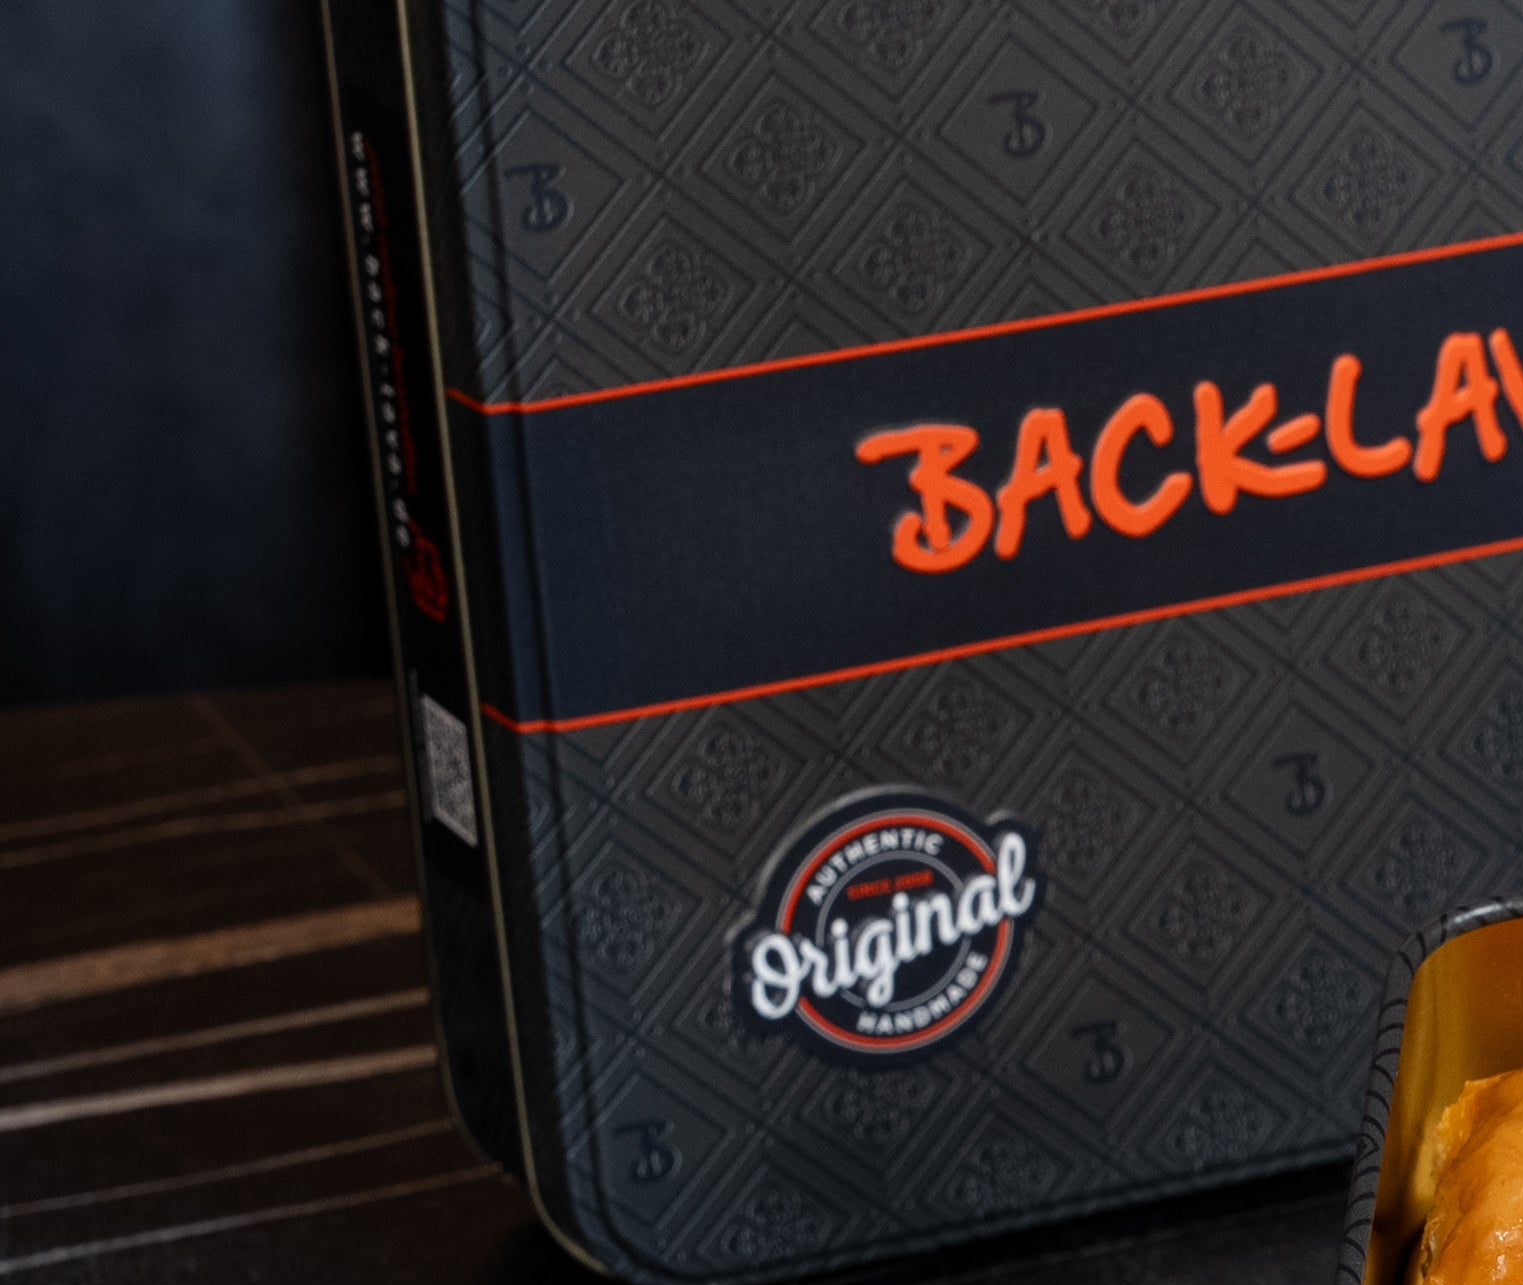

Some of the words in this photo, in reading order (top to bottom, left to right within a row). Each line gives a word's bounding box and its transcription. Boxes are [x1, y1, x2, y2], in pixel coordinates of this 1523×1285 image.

[807, 828, 945, 905] AUTHENTIC
[751, 831, 1037, 1020] Original
[856, 951, 989, 1035] HANDMADE
